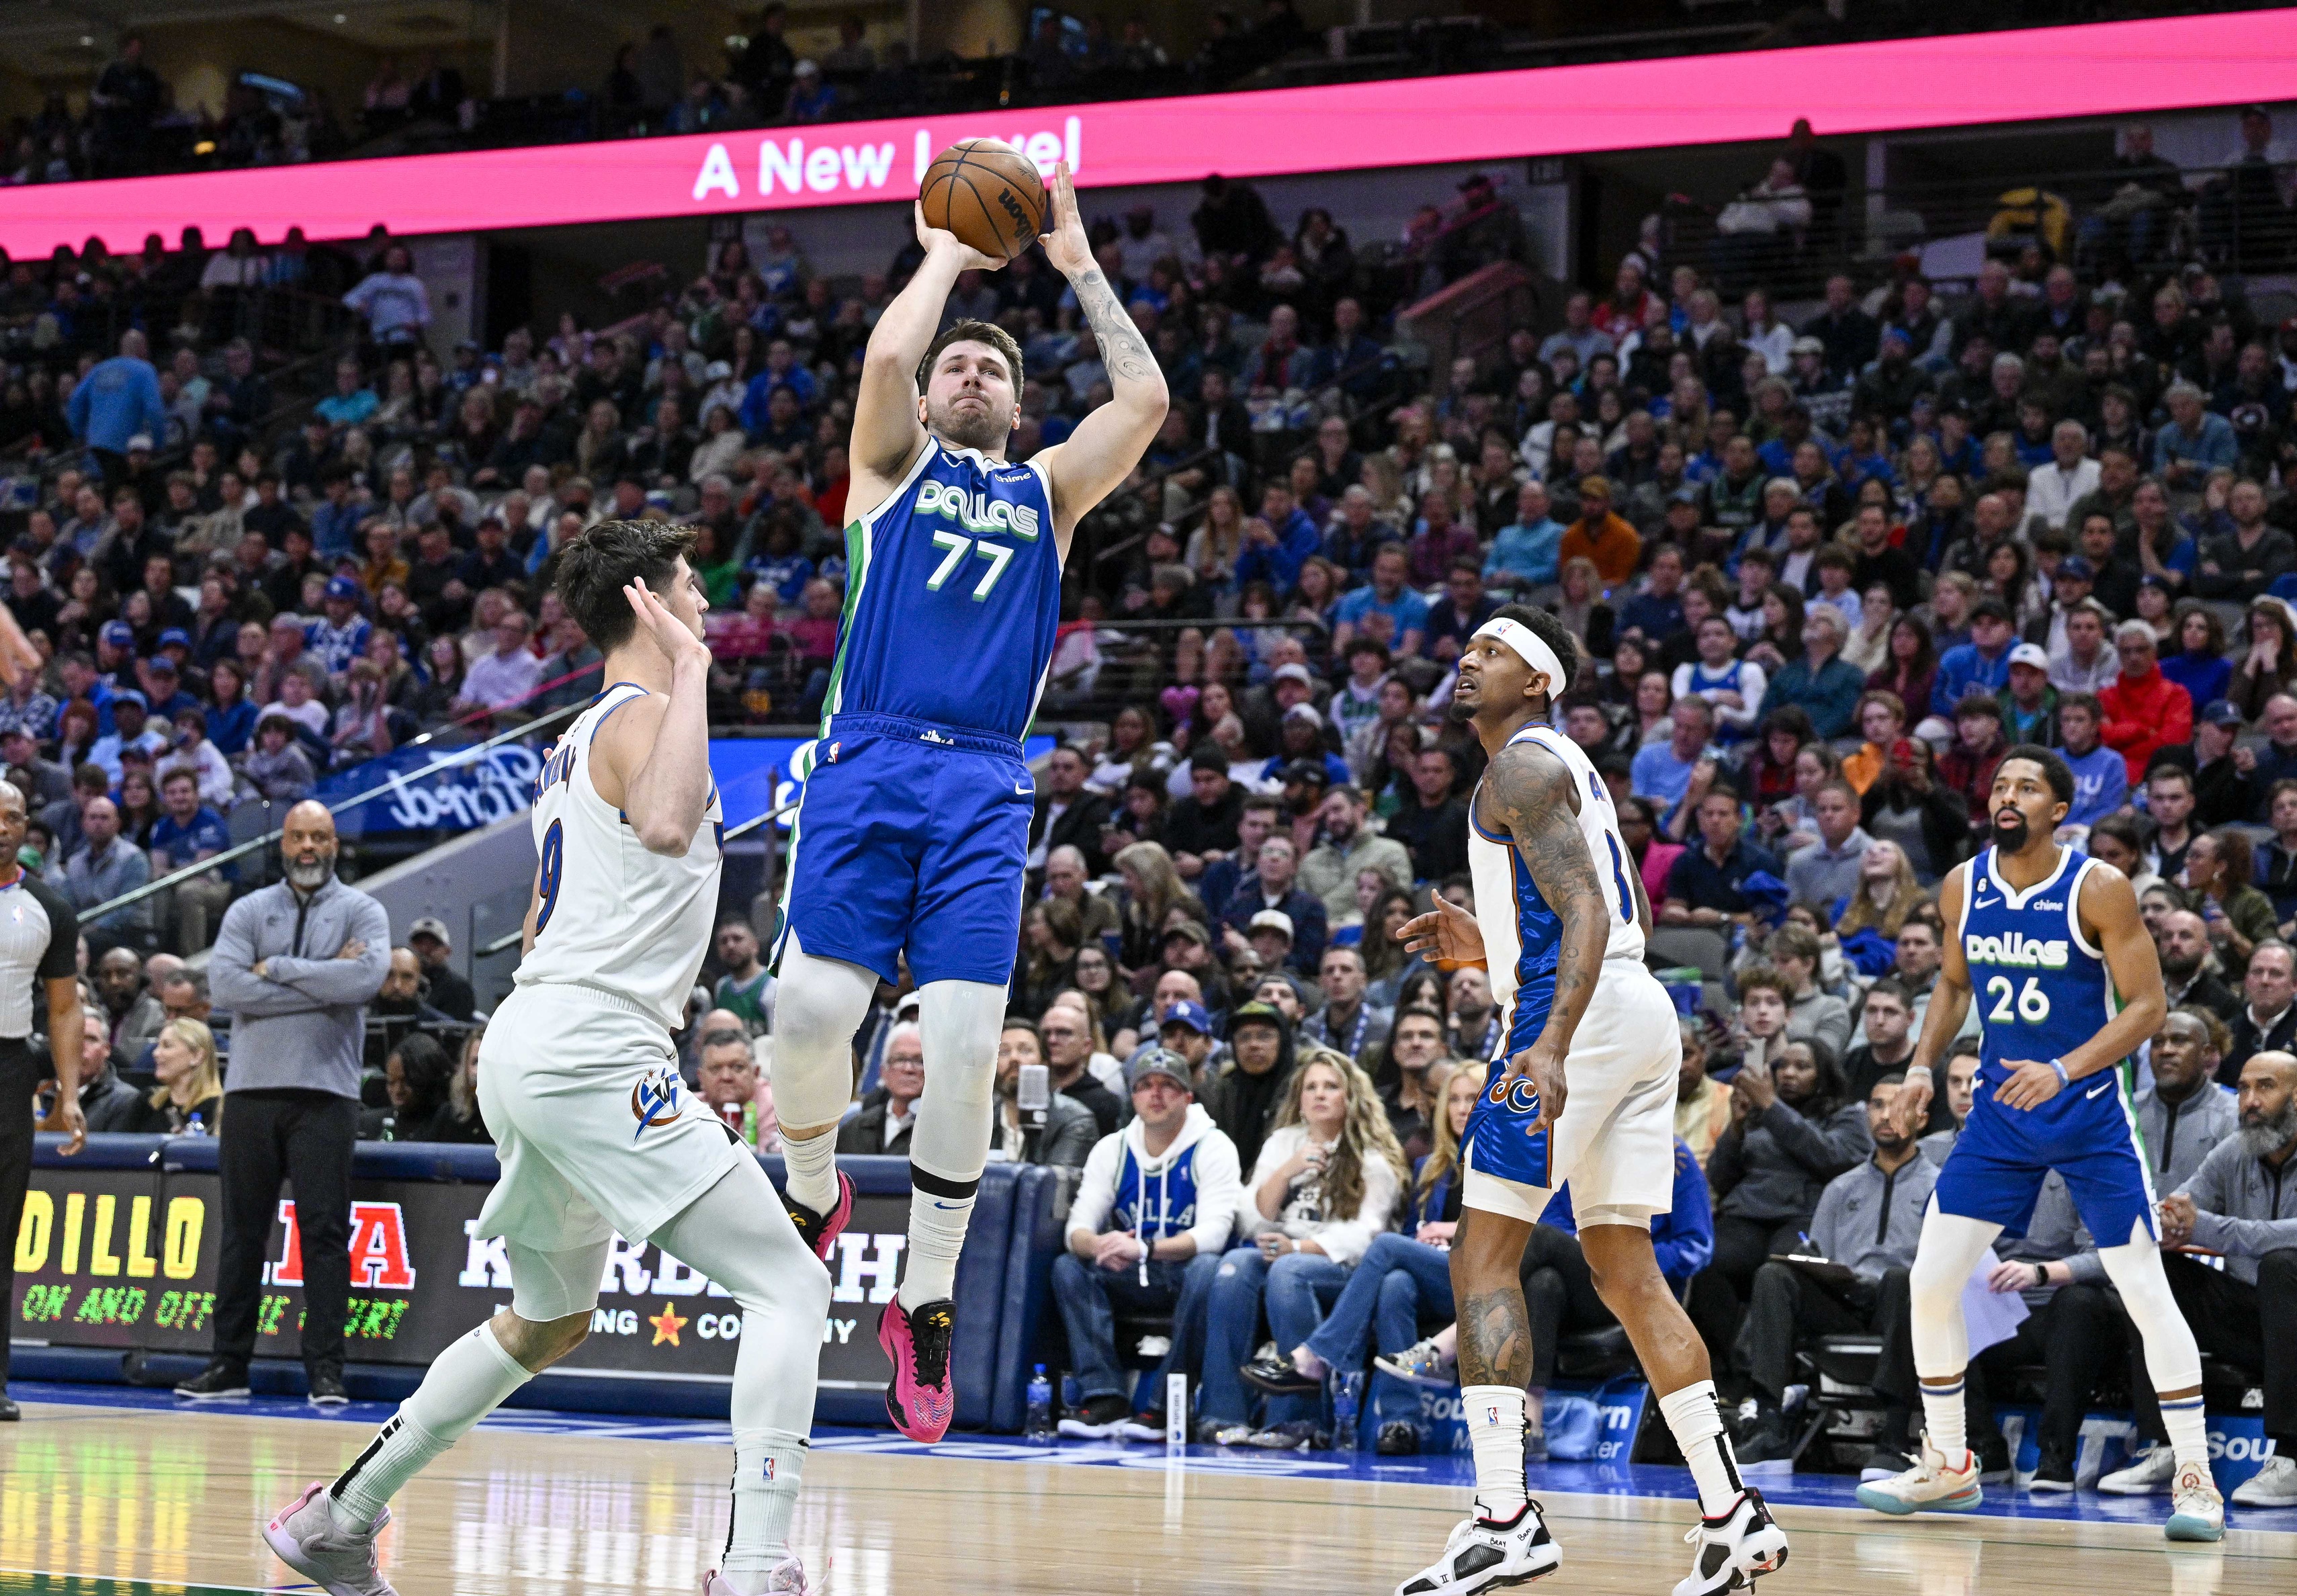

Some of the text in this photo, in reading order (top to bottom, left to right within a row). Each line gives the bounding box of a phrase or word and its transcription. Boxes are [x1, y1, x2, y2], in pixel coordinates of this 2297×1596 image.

[692, 143, 740, 201] A
[759, 138, 895, 195] New
[994, 472, 1032, 483] chime
[926, 529, 1014, 603] 77
[536, 817, 563, 935] 9
[2033, 899, 2063, 912] chime
[1987, 975, 2050, 1025] 26
[22, 1284, 72, 1322] ON
[73, 1286, 147, 1325] AND
